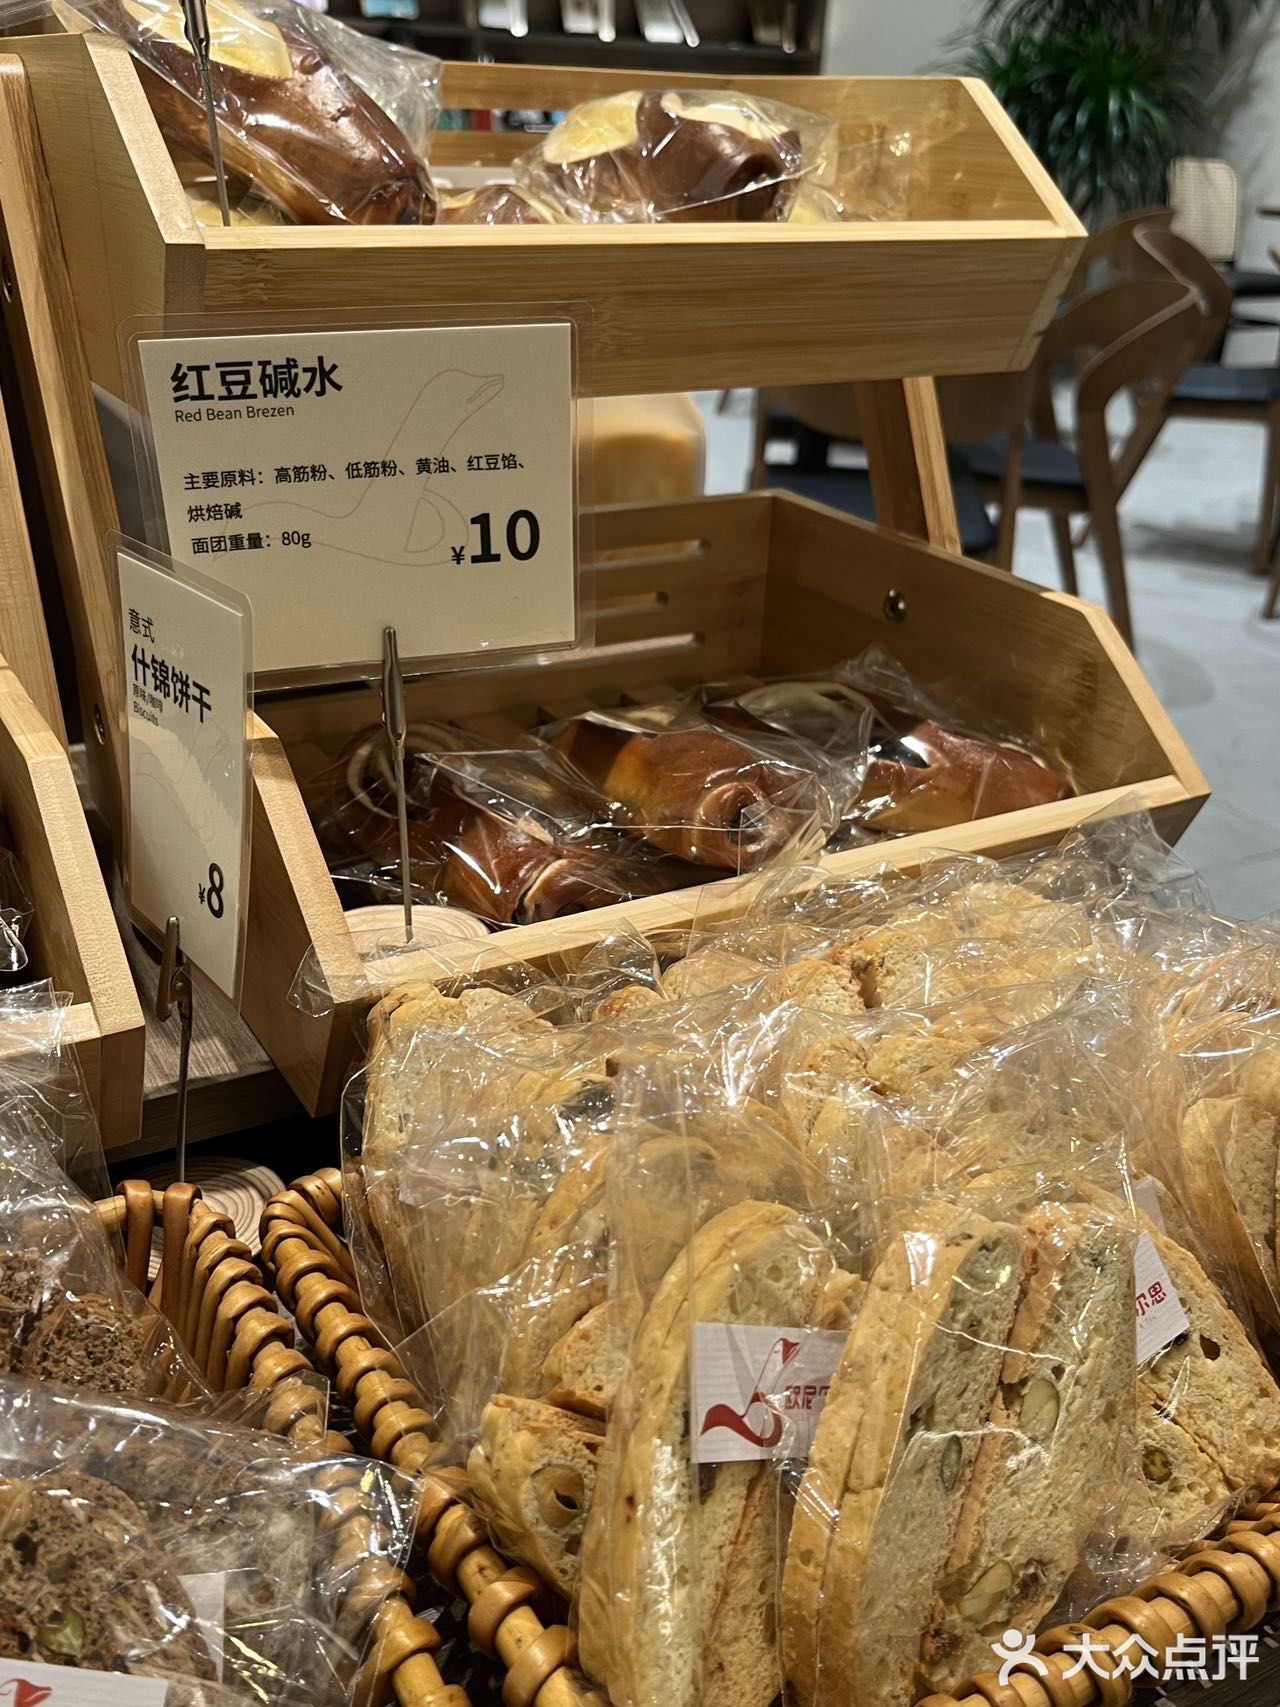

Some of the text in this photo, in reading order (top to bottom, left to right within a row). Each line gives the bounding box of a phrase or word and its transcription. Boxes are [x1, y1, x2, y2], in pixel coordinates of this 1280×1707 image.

[170, 355, 343, 402] 红豆碱水
[175, 404, 295, 423] Red Bean Brezen
[187, 502, 243, 523] 烘焙碱
[451, 509, 540, 565] ¥10
[128, 608, 155, 644] 意式
[131, 643, 212, 723] 什锦饼干
[198, 863, 224, 919] ¥8
